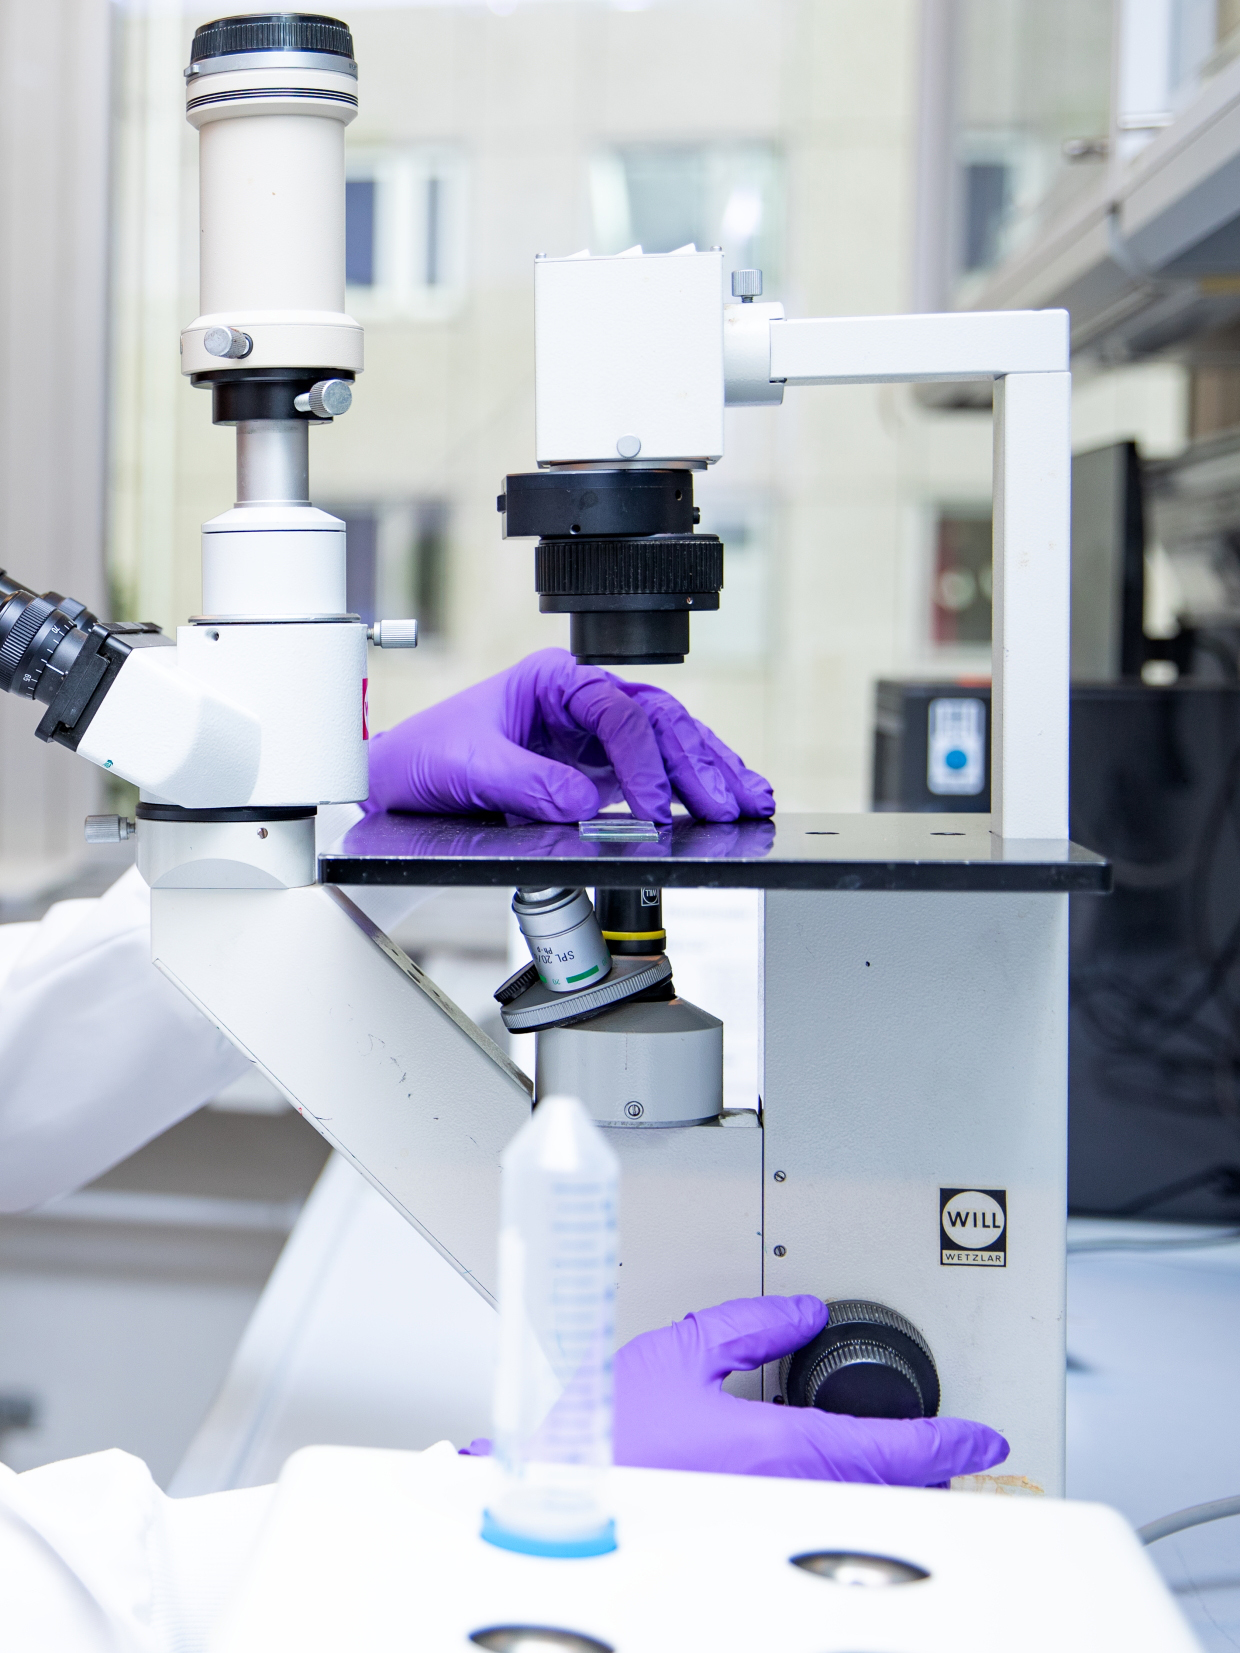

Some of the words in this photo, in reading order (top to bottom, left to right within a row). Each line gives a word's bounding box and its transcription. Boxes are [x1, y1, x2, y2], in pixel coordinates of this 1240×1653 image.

[555, 950, 575, 963] SPL
[947, 1211, 1001, 1228] WILL
[945, 1253, 1002, 1263] WETZLAR
